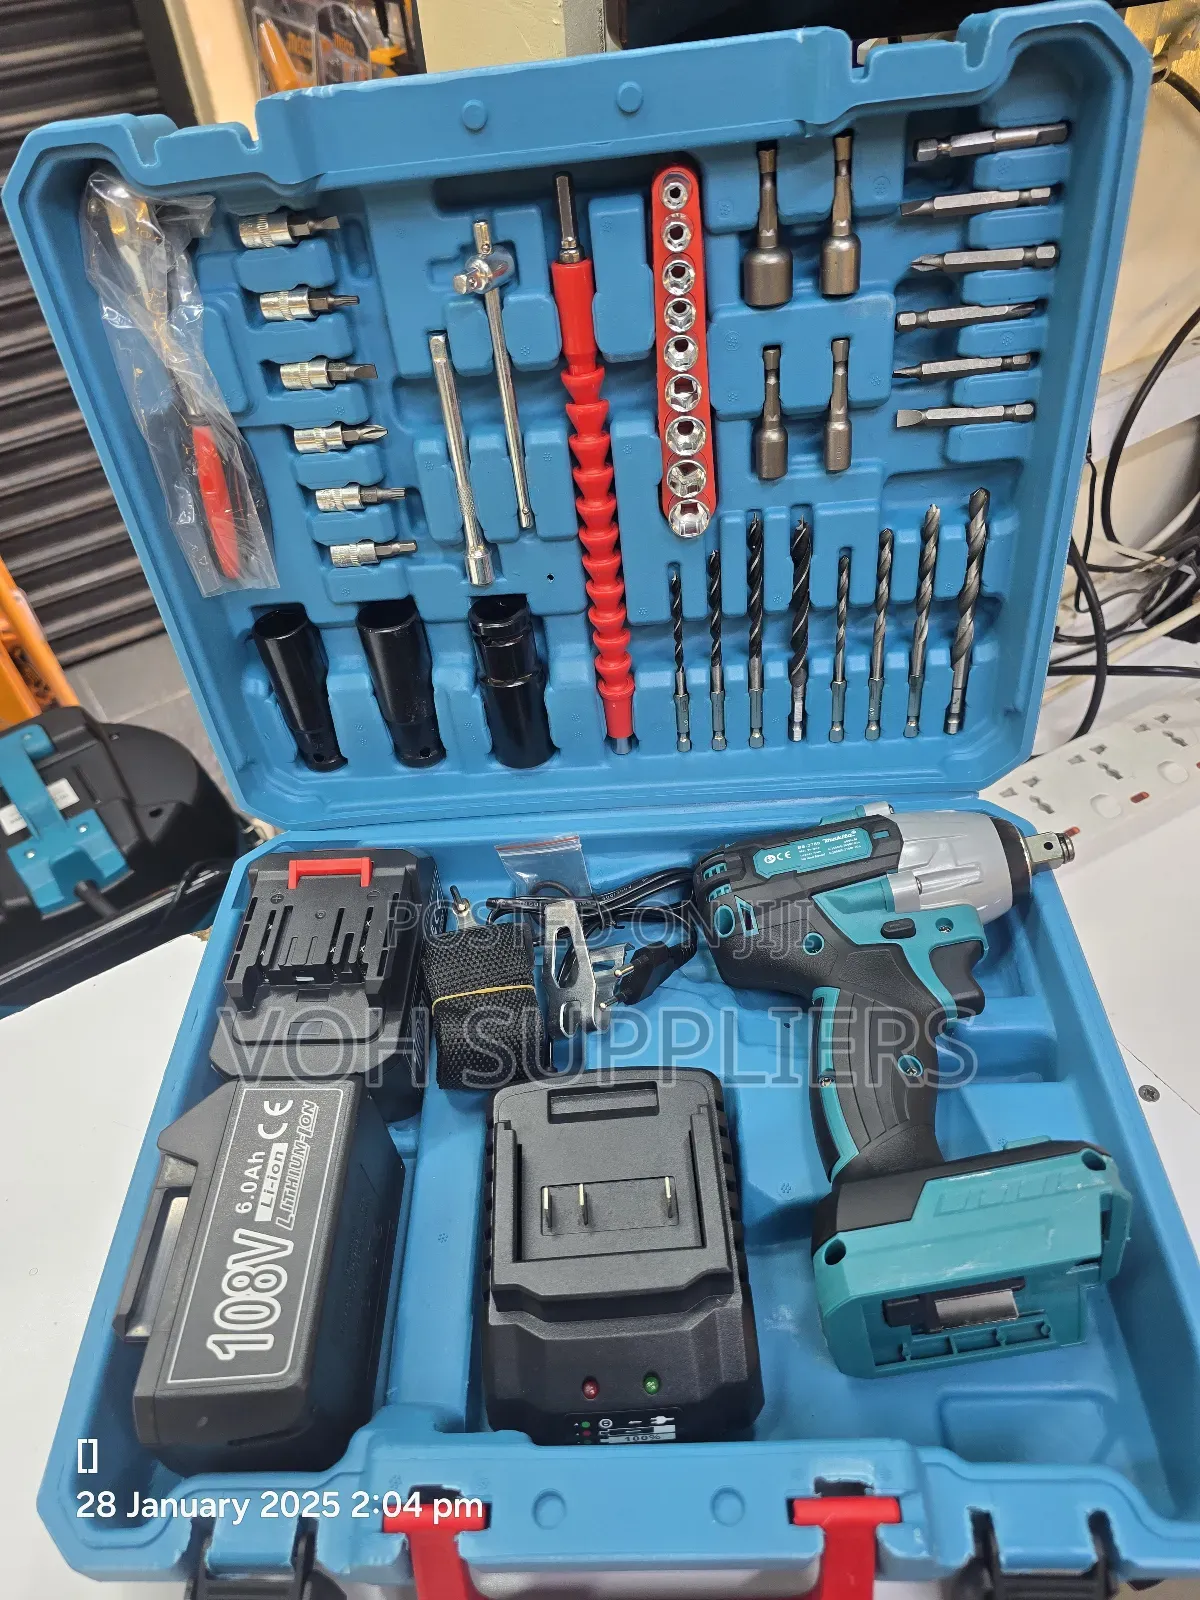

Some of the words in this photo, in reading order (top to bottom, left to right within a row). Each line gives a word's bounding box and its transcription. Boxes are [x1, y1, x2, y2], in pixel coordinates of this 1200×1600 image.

[235, 1151, 266, 1214] 6.0Ah
[260, 1150, 286, 1209] Li-ion
[206, 1228, 295, 1361] 108V
[624, 1433, 661, 1442] 100%
